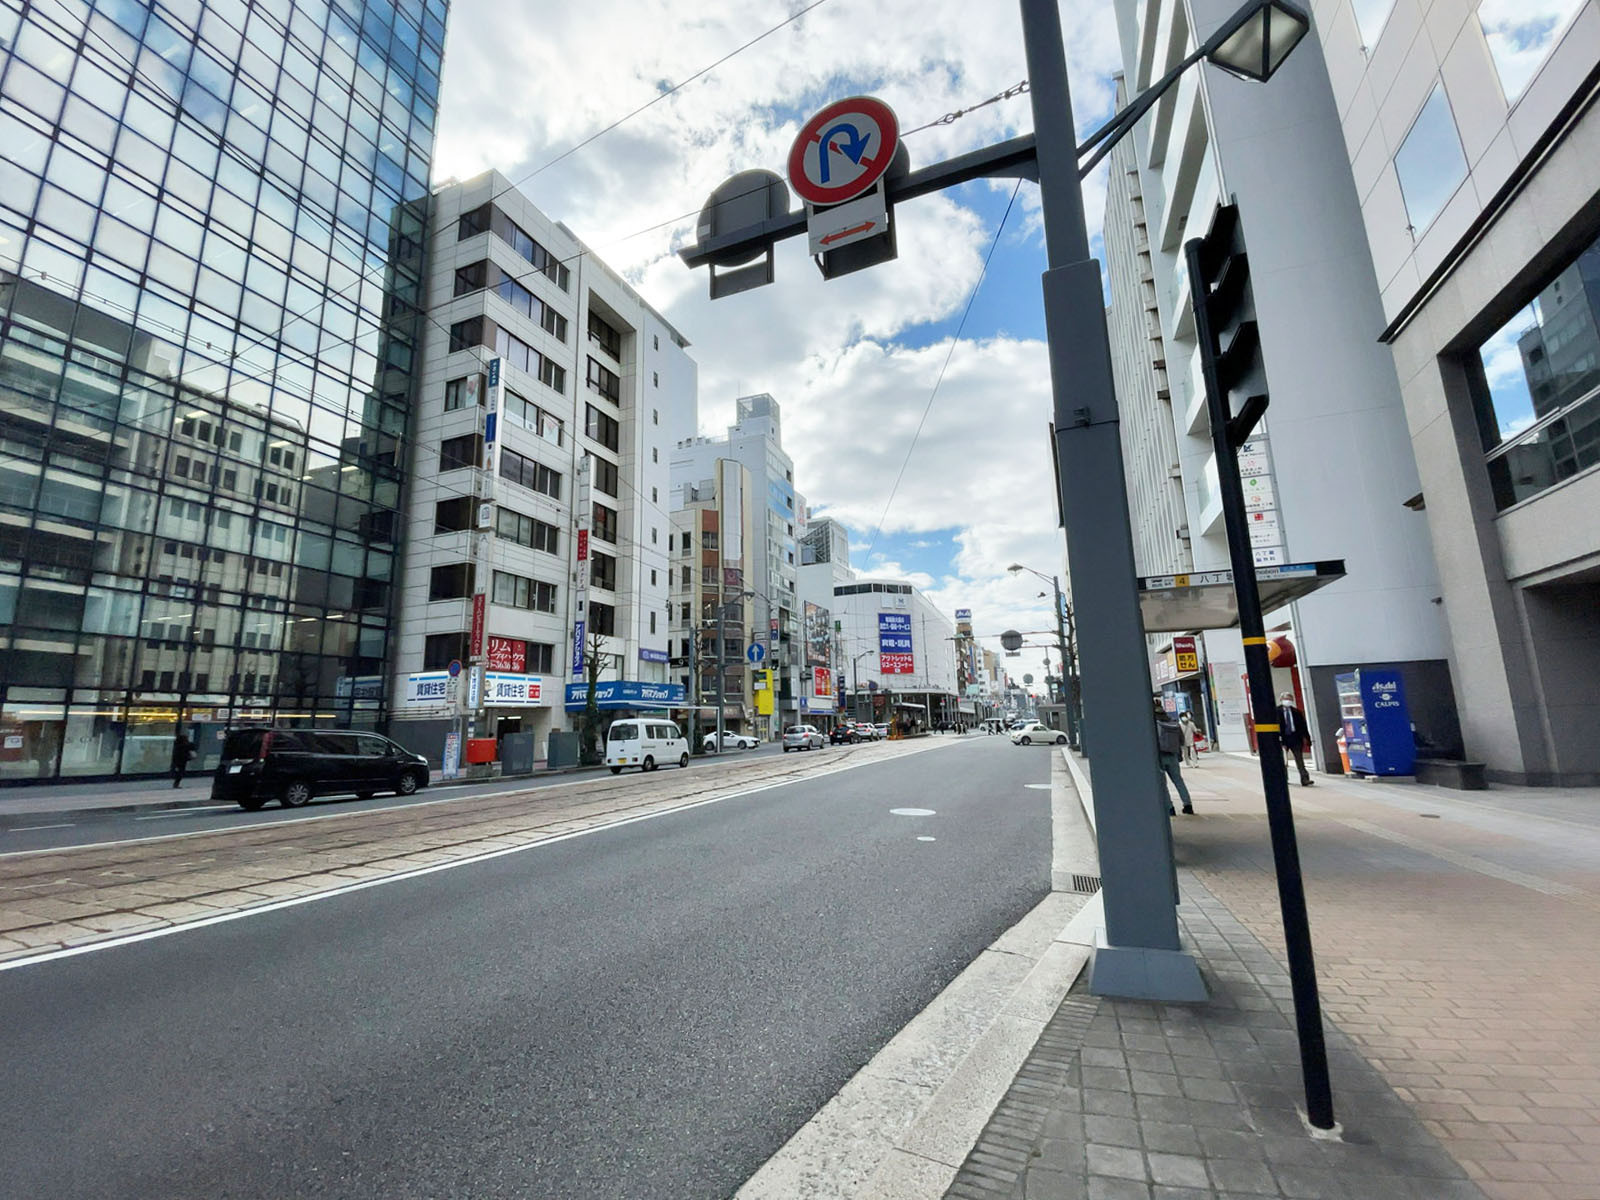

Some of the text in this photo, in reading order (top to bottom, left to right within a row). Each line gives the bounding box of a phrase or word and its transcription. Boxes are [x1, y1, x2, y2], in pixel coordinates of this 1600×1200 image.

[416, 682, 446, 696] 賃貸住宅
[496, 682, 525, 698] 賃貸住宅
[1372, 681, 1397, 691] Asahi
